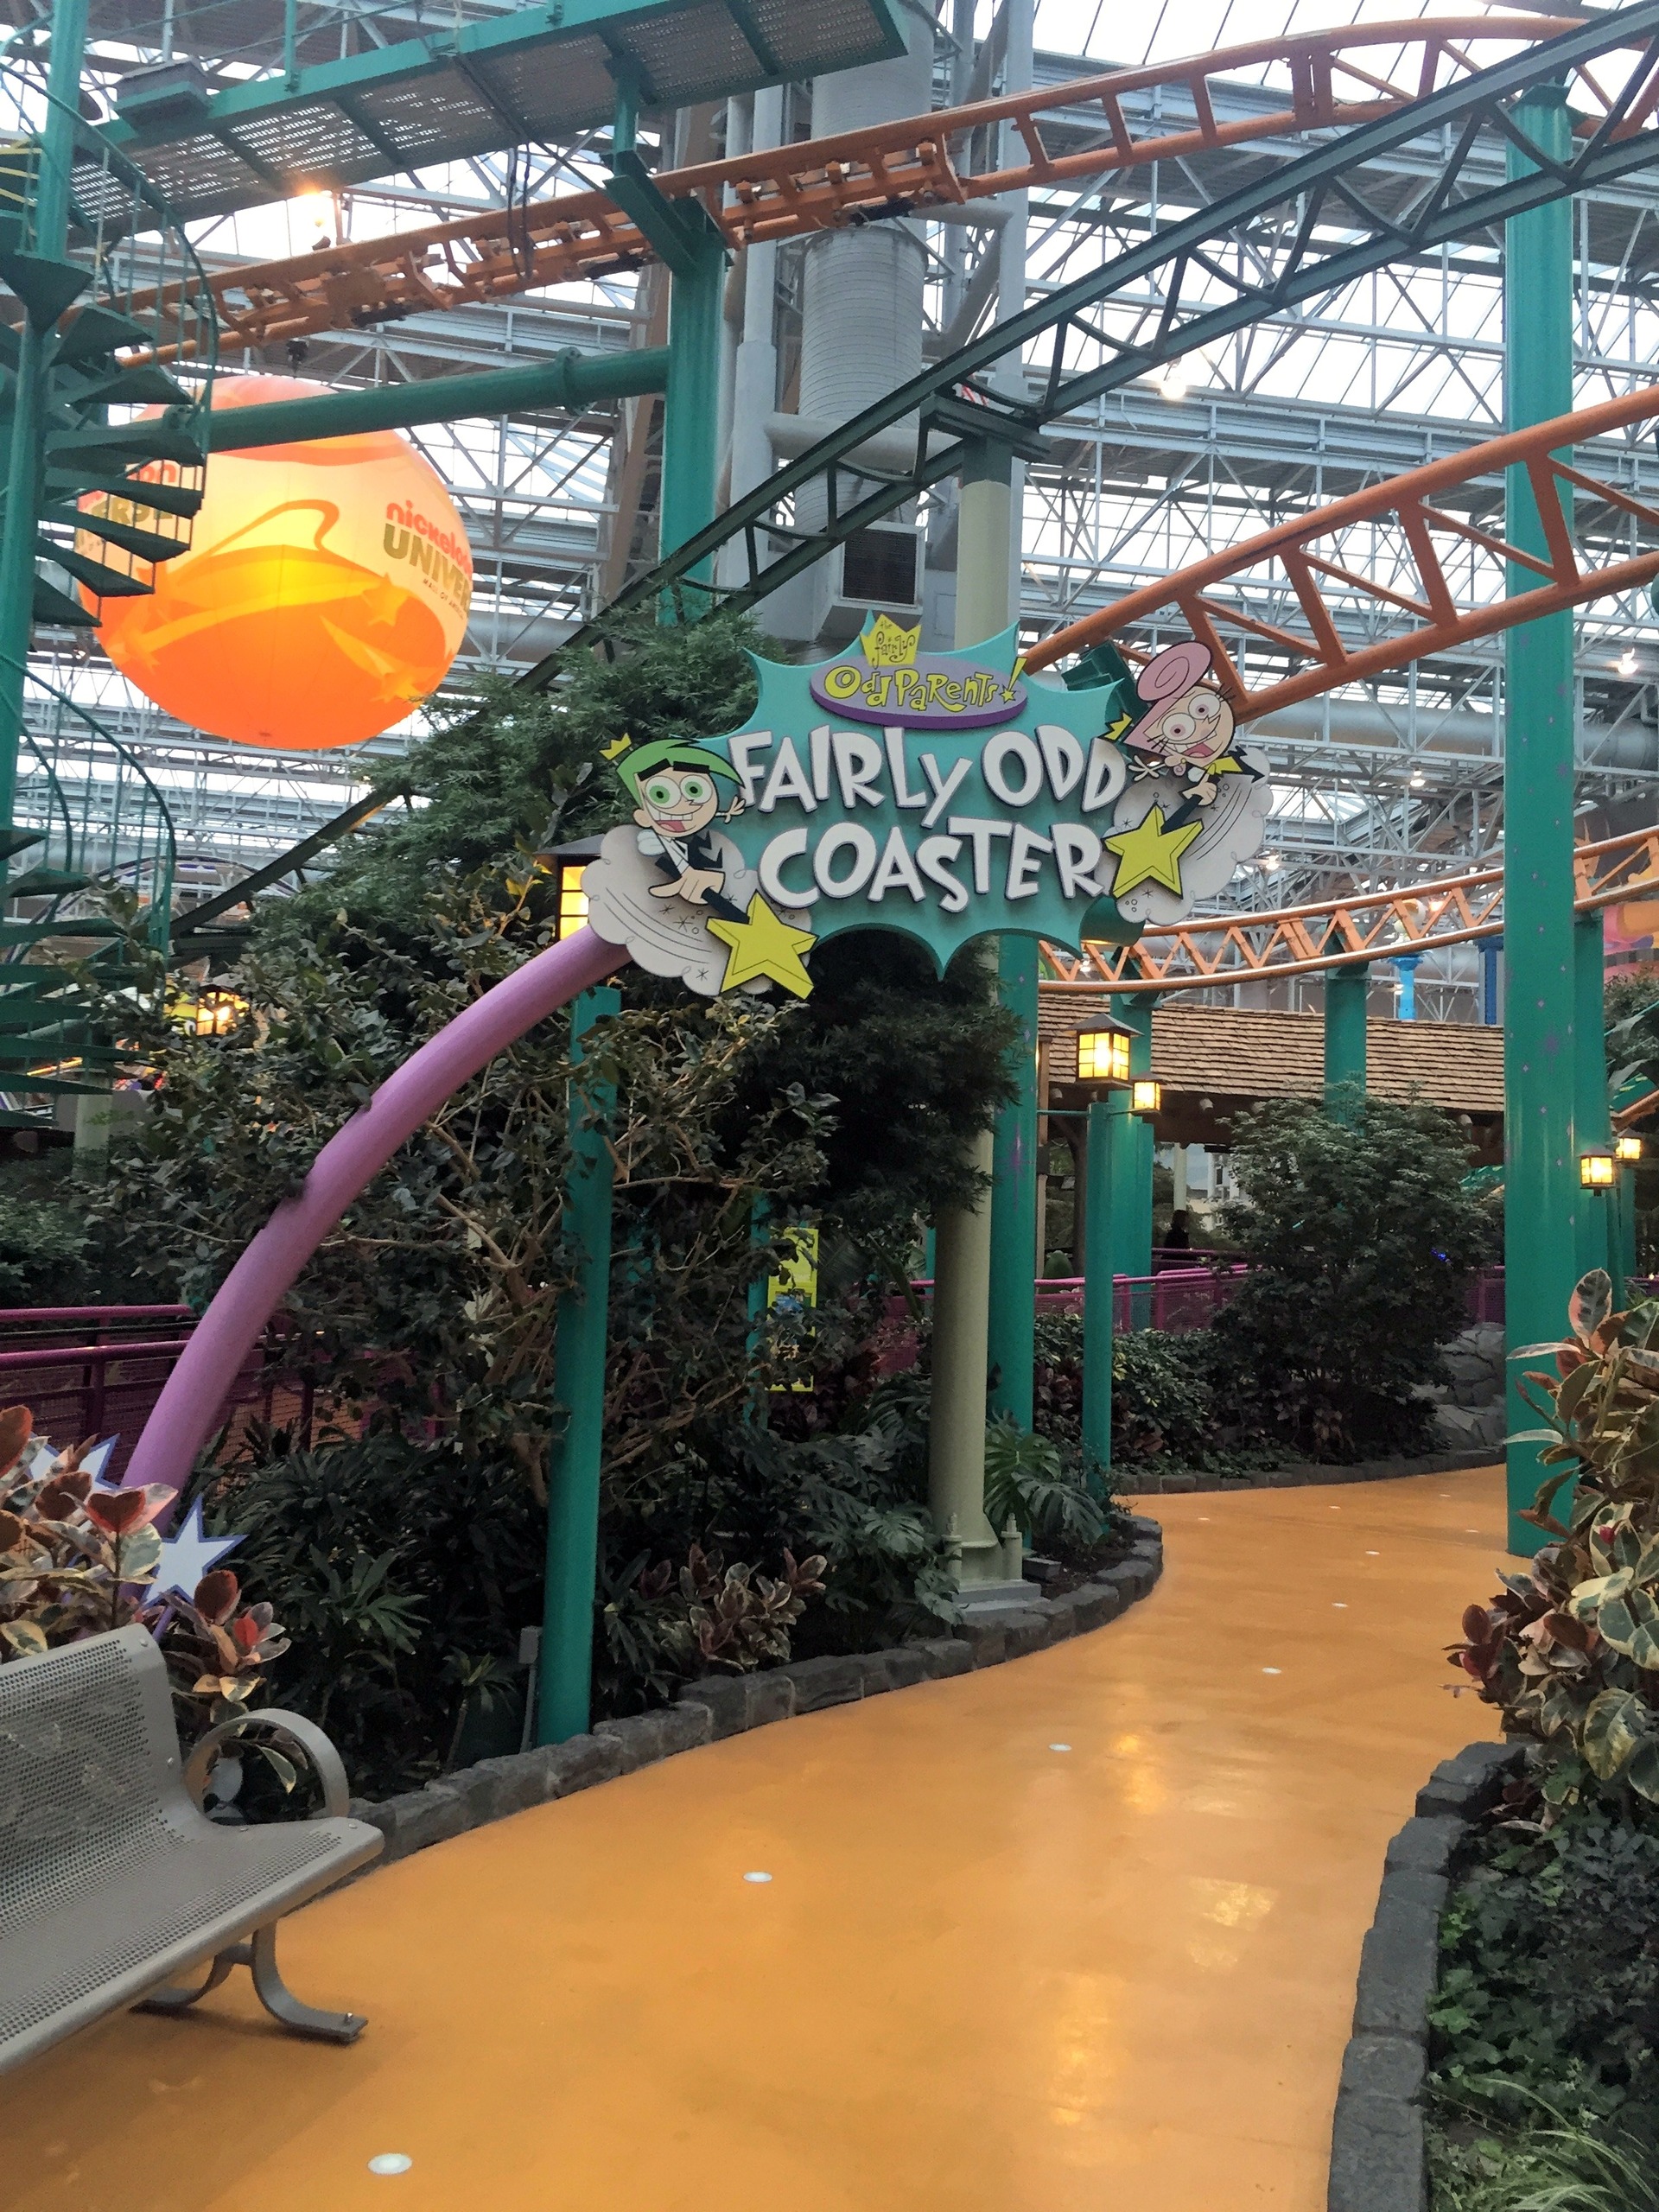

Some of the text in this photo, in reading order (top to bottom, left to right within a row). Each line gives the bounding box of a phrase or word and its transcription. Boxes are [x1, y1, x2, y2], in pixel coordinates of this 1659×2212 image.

[872, 631, 916, 670] fairly
[880, 620, 893, 630] the
[981, 724, 1127, 812] ODD
[758, 816, 1105, 913] COASTER
